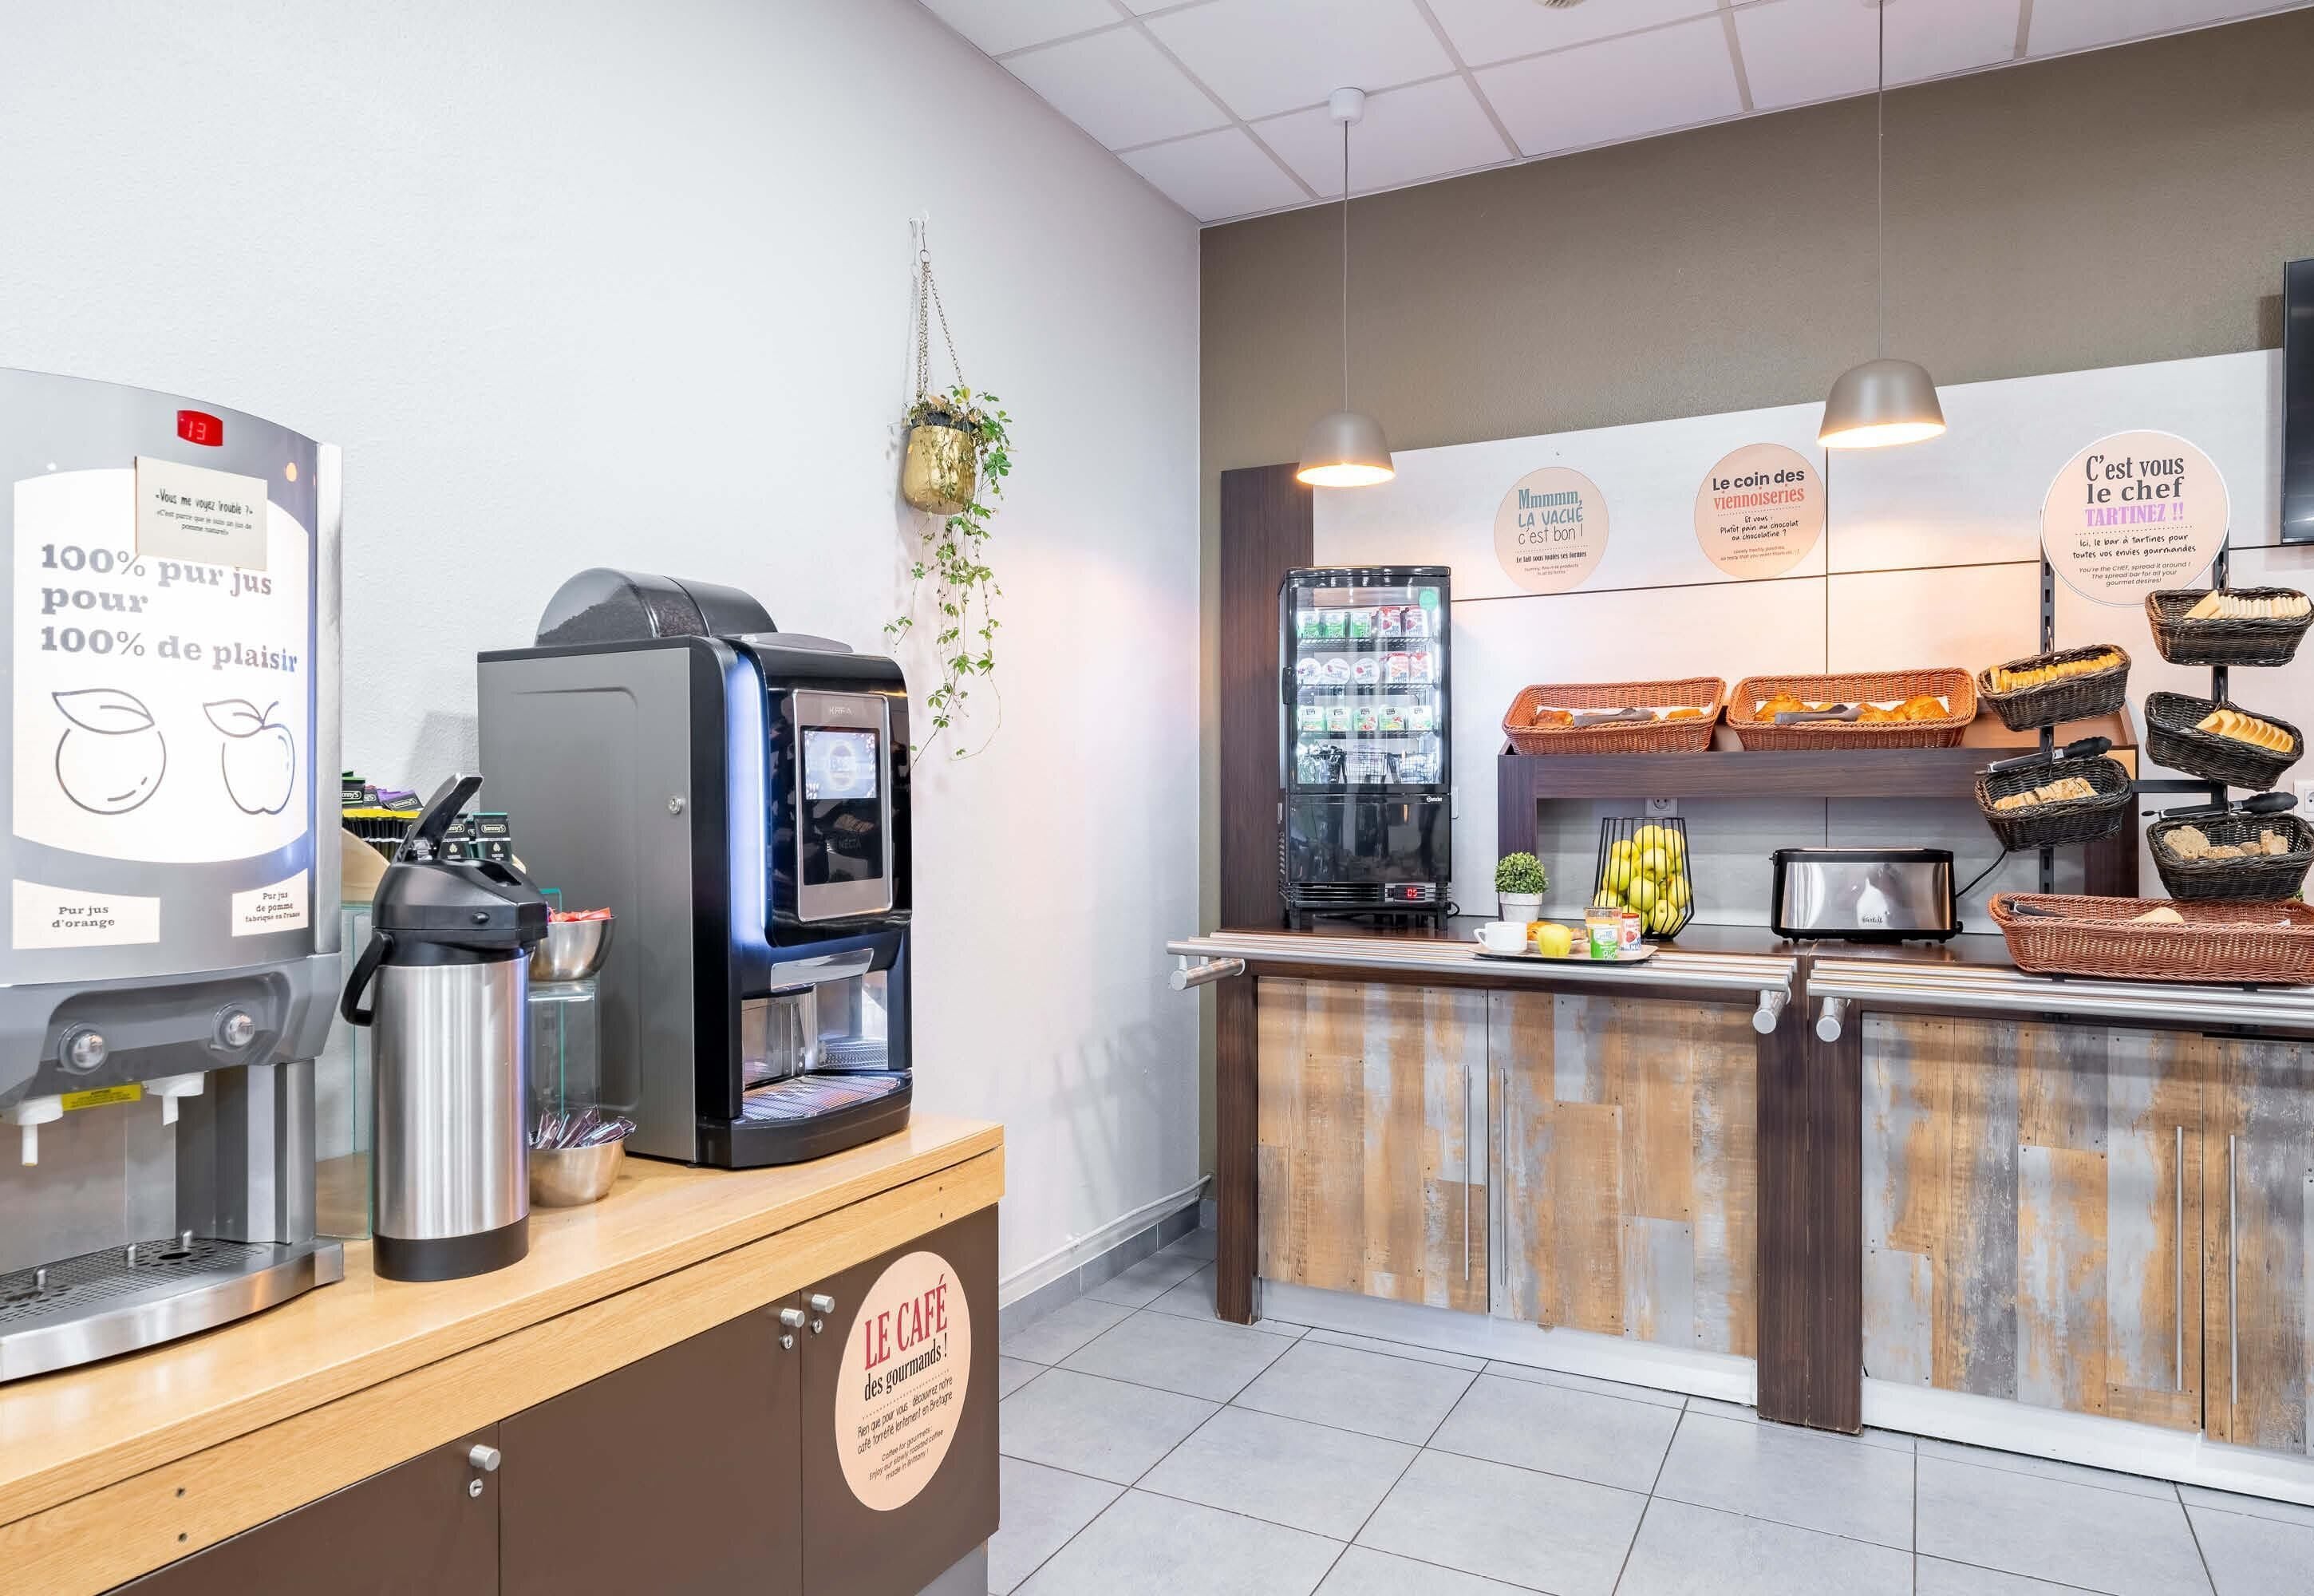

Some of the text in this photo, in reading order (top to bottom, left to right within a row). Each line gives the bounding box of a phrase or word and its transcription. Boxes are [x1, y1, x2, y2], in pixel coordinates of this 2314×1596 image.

[188, 421, 206, 440] 13
[1713, 468, 1805, 492] Le coin des
[2086, 454, 2185, 482] C'est vous
[1714, 483, 1805, 511] viennoiseries
[2087, 476, 2185, 504] le chef
[181, 496, 192, 506] me
[195, 499, 215, 512] voyez
[2084, 502, 2184, 527] TARTINEZ !!
[1518, 507, 1584, 528] LA VACHE
[1720, 524, 1739, 534] Plutôt
[1742, 525, 1756, 534] pain
[1518, 526, 1550, 545] c'est
[1554, 525, 1576, 542] bon
[1742, 531, 1779, 541] chocolatine
[2131, 534, 2165, 544] tartines
[2168, 534, 2189, 544] pour
[2073, 551, 2096, 559] toutes
[2143, 544, 2197, 557] gourmandes
[41, 543, 271, 596] 100% pur jus
[41, 587, 148, 614] pour
[41, 626, 298, 672] 100% de plaisir
[58, 905, 109, 916] Pur jus
[268, 903, 294, 913] pomme
[52, 917, 116, 930] d'orange
[865, 1274, 948, 1371] LE CAFÉ
[864, 1333, 948, 1402] des gourmands !
[858, 1424, 870, 1440] Rien
[871, 1418, 881, 1432] que
[882, 1409, 894, 1428] pour
[896, 1402, 908, 1416] vous
[912, 1385, 938, 1406] découvrez
[938, 1377, 953, 1389] notre
[858, 1437, 871, 1455] café
[895, 1407, 922, 1432] lentement
[922, 1404, 930, 1416] en
[930, 1391, 953, 1412] Bretagne
